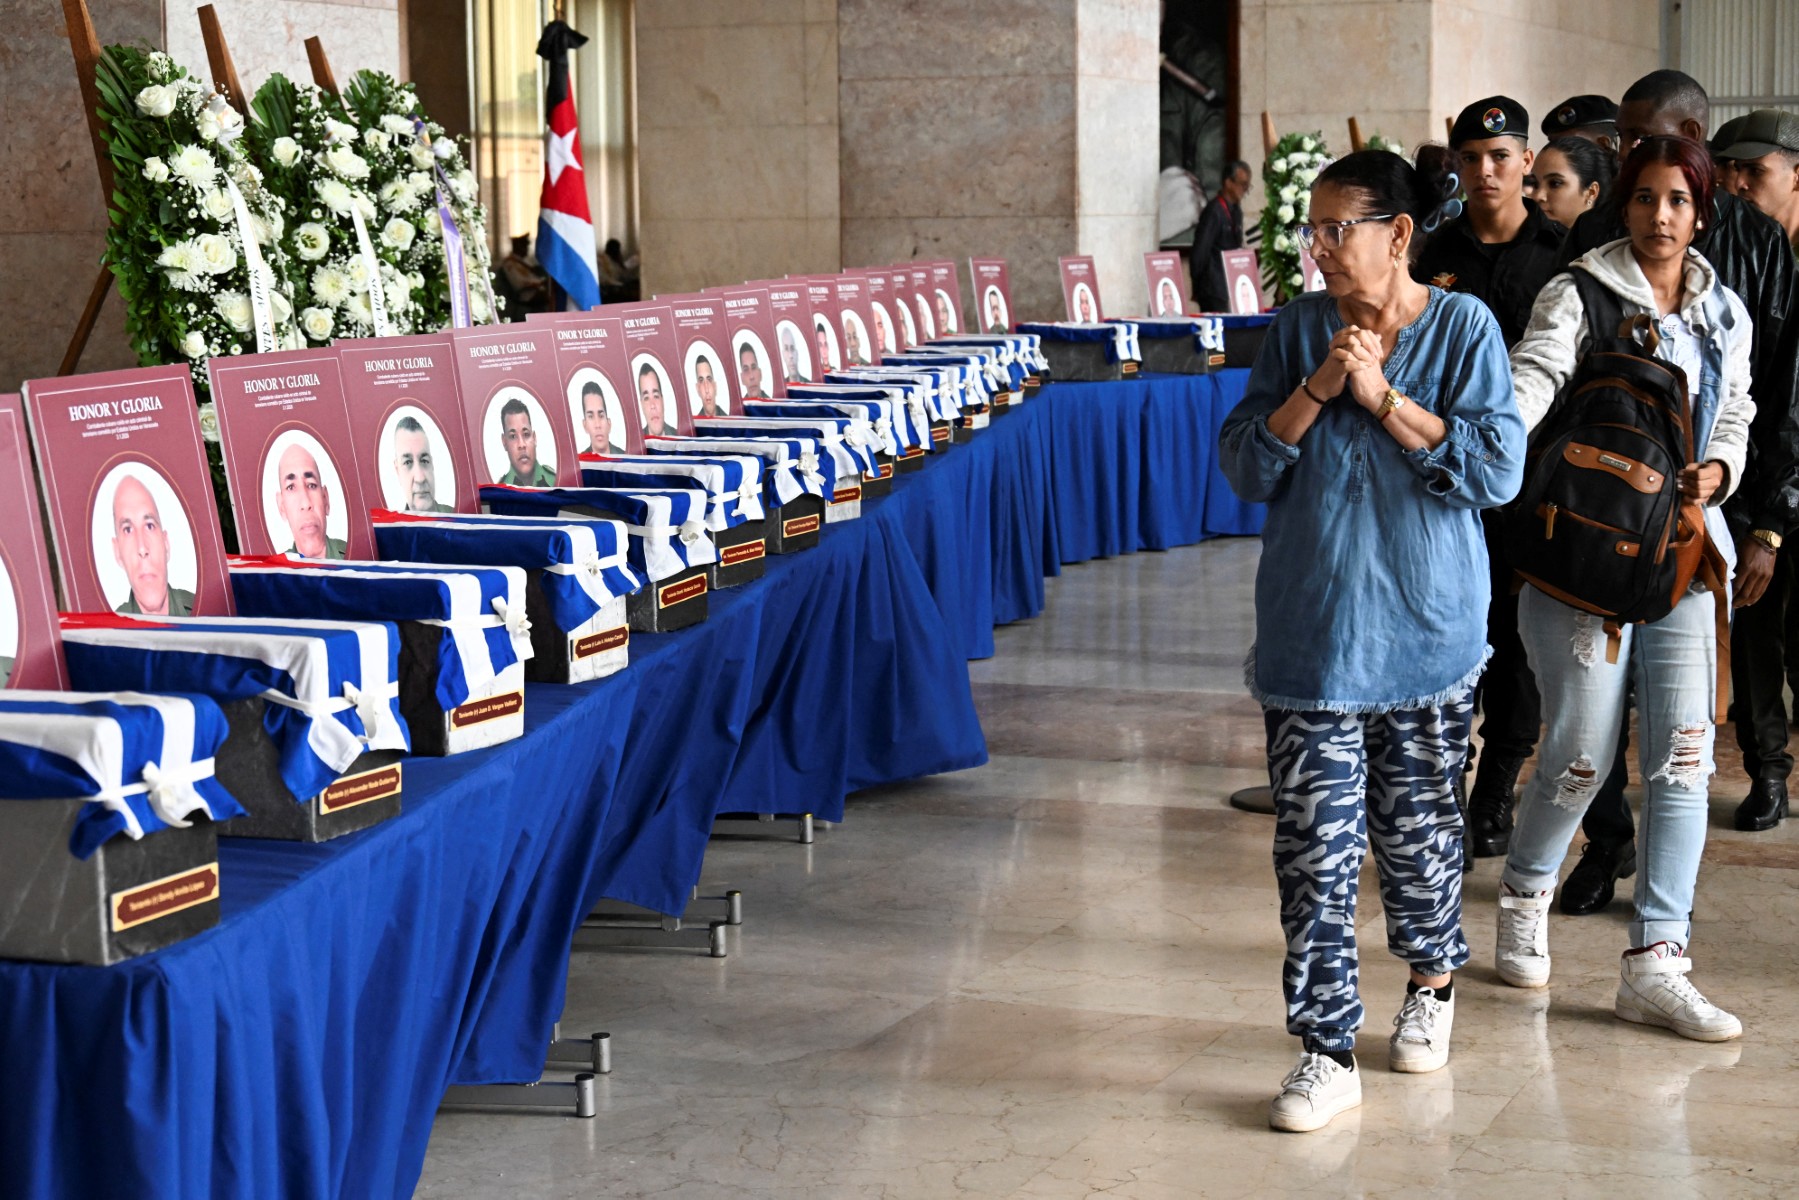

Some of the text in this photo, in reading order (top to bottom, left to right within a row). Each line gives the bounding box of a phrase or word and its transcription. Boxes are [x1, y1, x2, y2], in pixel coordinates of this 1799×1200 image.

[639, 317, 660, 326] GLORIA
[557, 328, 607, 339] ONOR Y GLORIA
[470, 342, 535, 357] HONOR Y GLORIA
[365, 357, 433, 371] HONOR Y GLORIA
[244, 374, 320, 393] HONOR Y GLORIA
[69, 396, 162, 421] HONOR Y GLORIA
